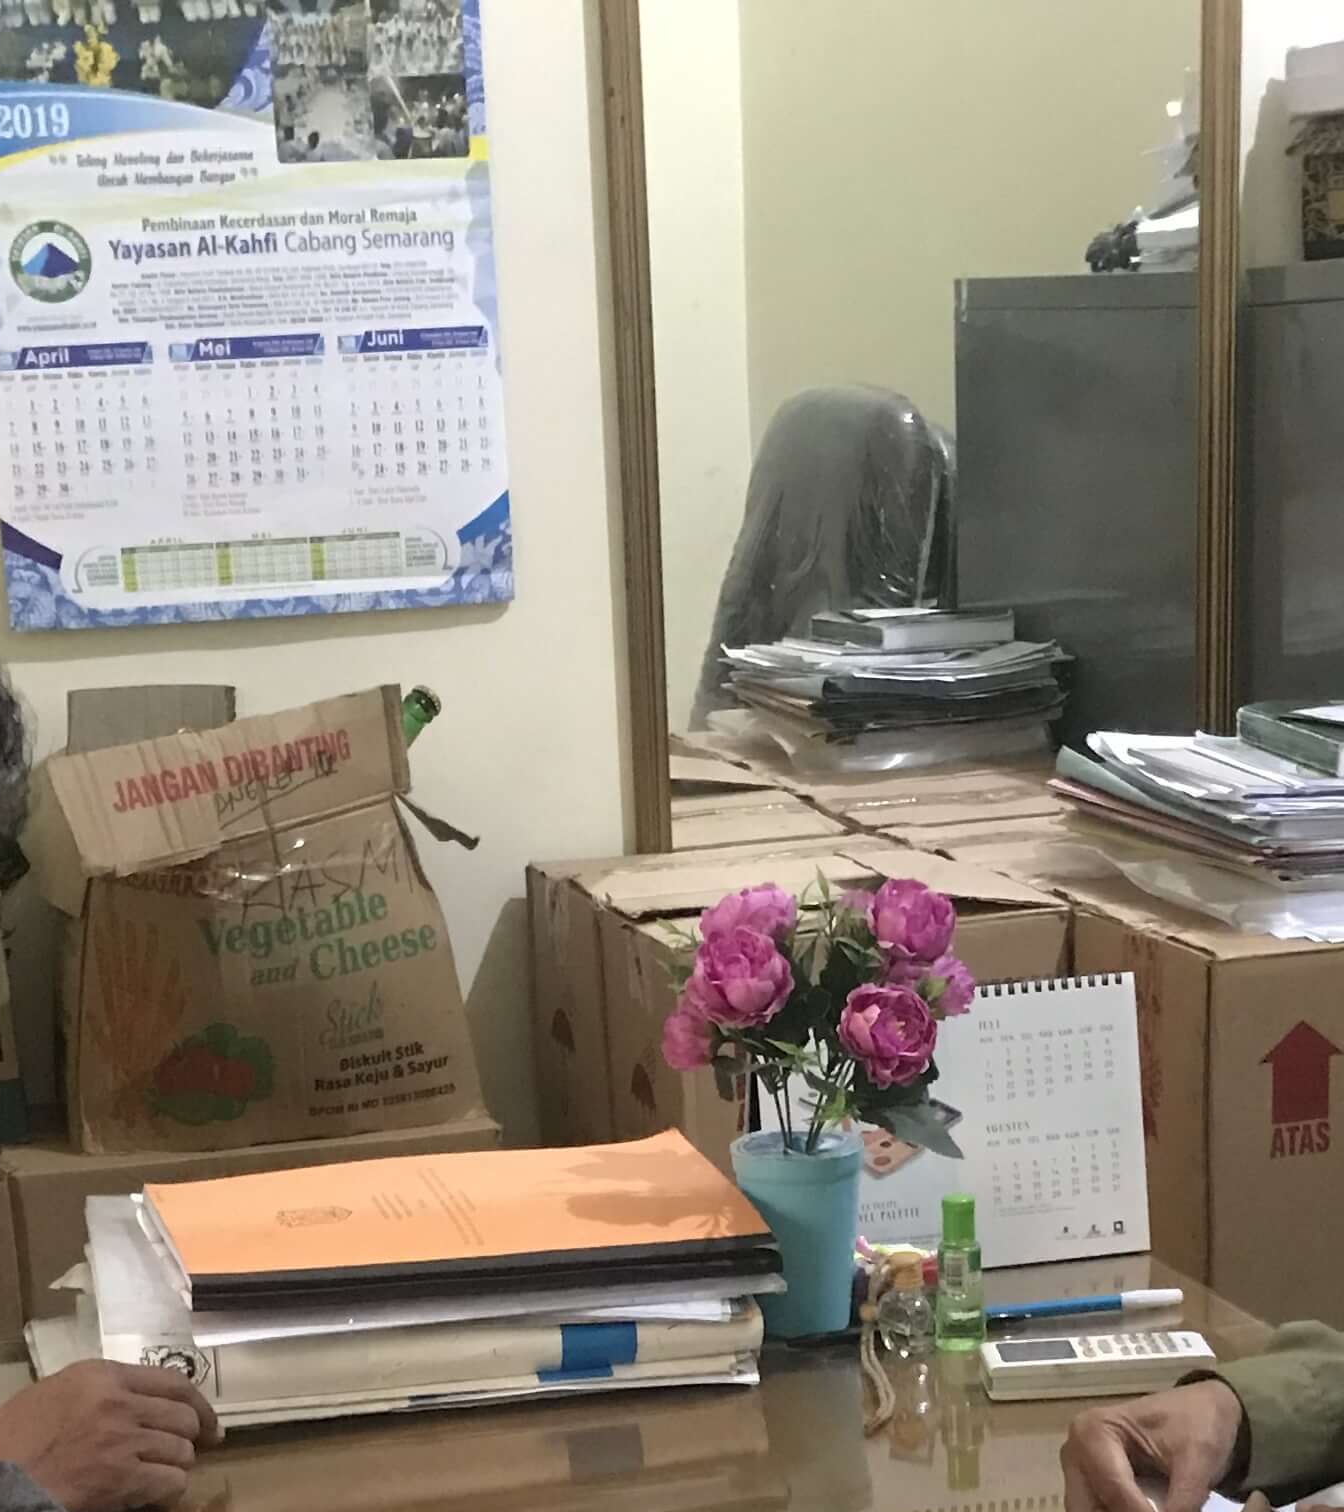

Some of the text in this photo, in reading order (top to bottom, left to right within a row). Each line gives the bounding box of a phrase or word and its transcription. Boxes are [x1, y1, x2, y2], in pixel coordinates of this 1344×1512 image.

[141, 207, 418, 232] Pembinaan Kecerdasan dan Moral Remaja
[108, 239, 192, 265] Yayasan
[197, 232, 278, 256] Al-Kahfi
[284, 230, 356, 255] Cabang
[361, 228, 455, 253] Semarang
[199, 339, 231, 357] Mei
[367, 328, 404, 347] Juni
[24, 347, 70, 368] April
[112, 759, 219, 813] JANGAN
[223, 729, 352, 785] DIBANTING
[195, 888, 388, 960] Vegetable
[252, 924, 438, 986] and Cheese
[314, 1055, 449, 1092] Rasa Keju & Sayur
[339, 1041, 425, 1072] Biskuit Stik
[1269, 1120, 1332, 1160] ATAS
